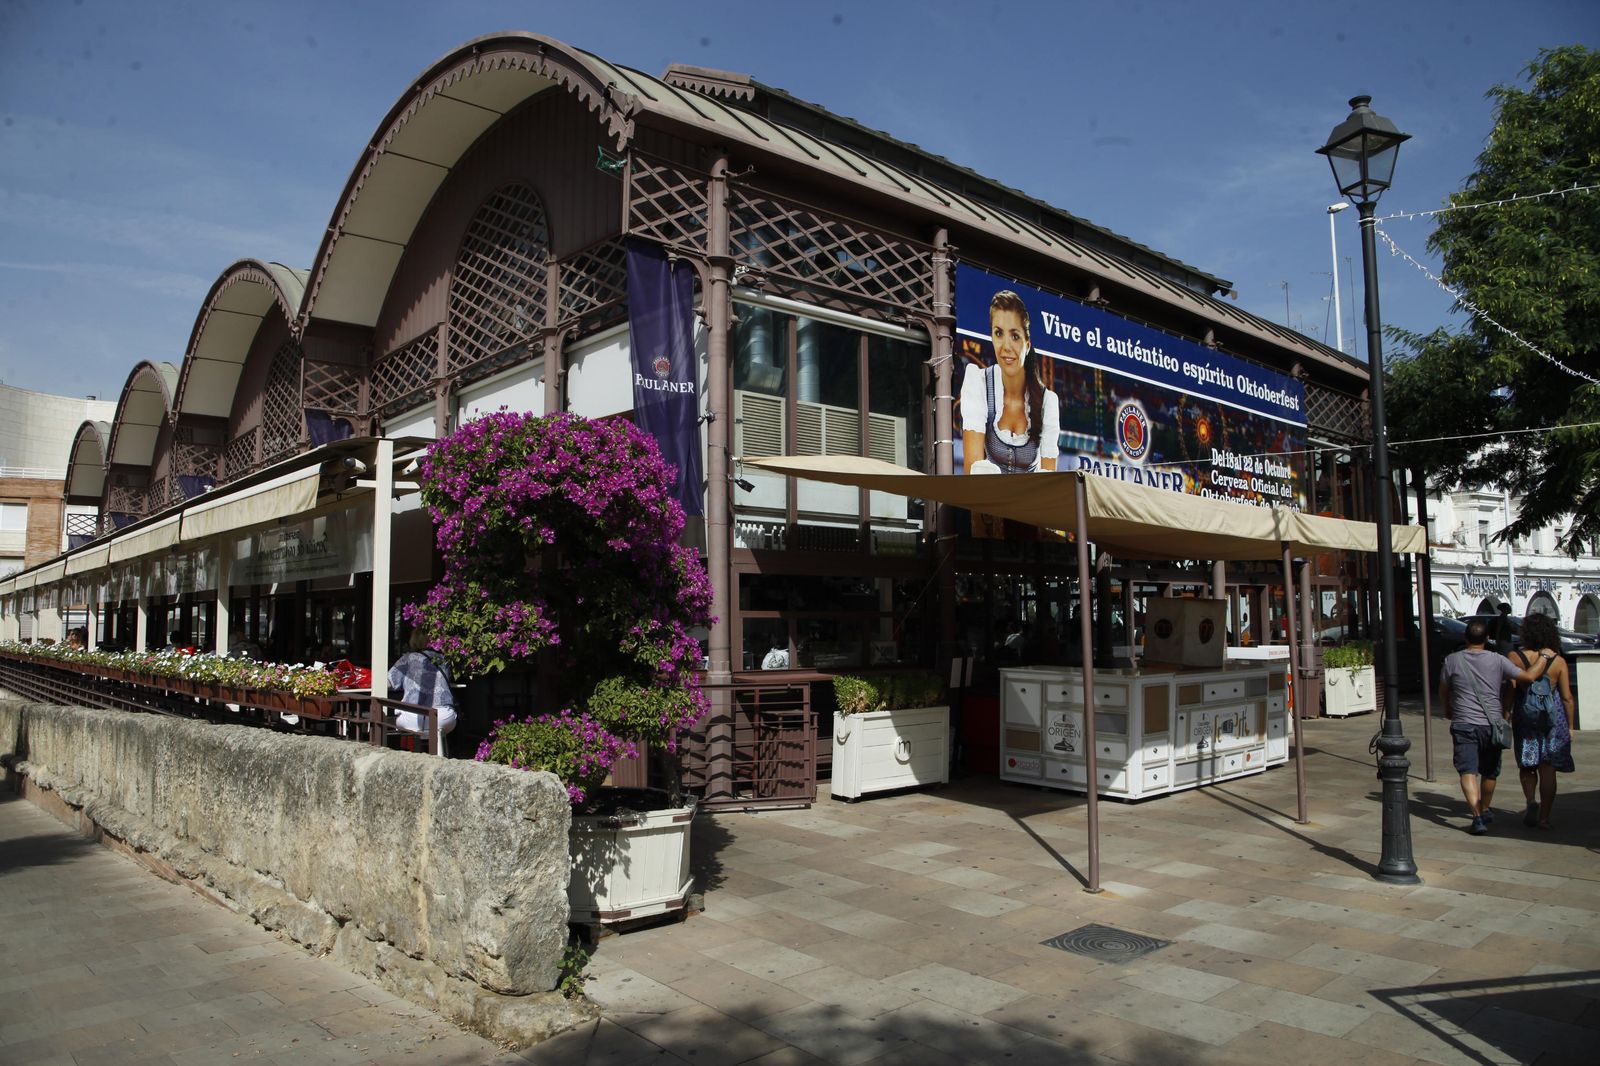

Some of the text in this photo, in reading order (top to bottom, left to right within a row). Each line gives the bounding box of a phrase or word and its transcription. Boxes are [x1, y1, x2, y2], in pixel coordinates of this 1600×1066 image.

[1041, 310, 1300, 411] Vive el auténtico espíritu Oktoberfest
[1211, 447, 1225, 467] Del
[1243, 456, 1254, 473] 22
[1254, 457, 1264, 475] de
[1264, 459, 1292, 480] Octubre
[1211, 470, 1292, 498] Cerveza Oficial del
[1048, 727, 1081, 739] ORIGEN
